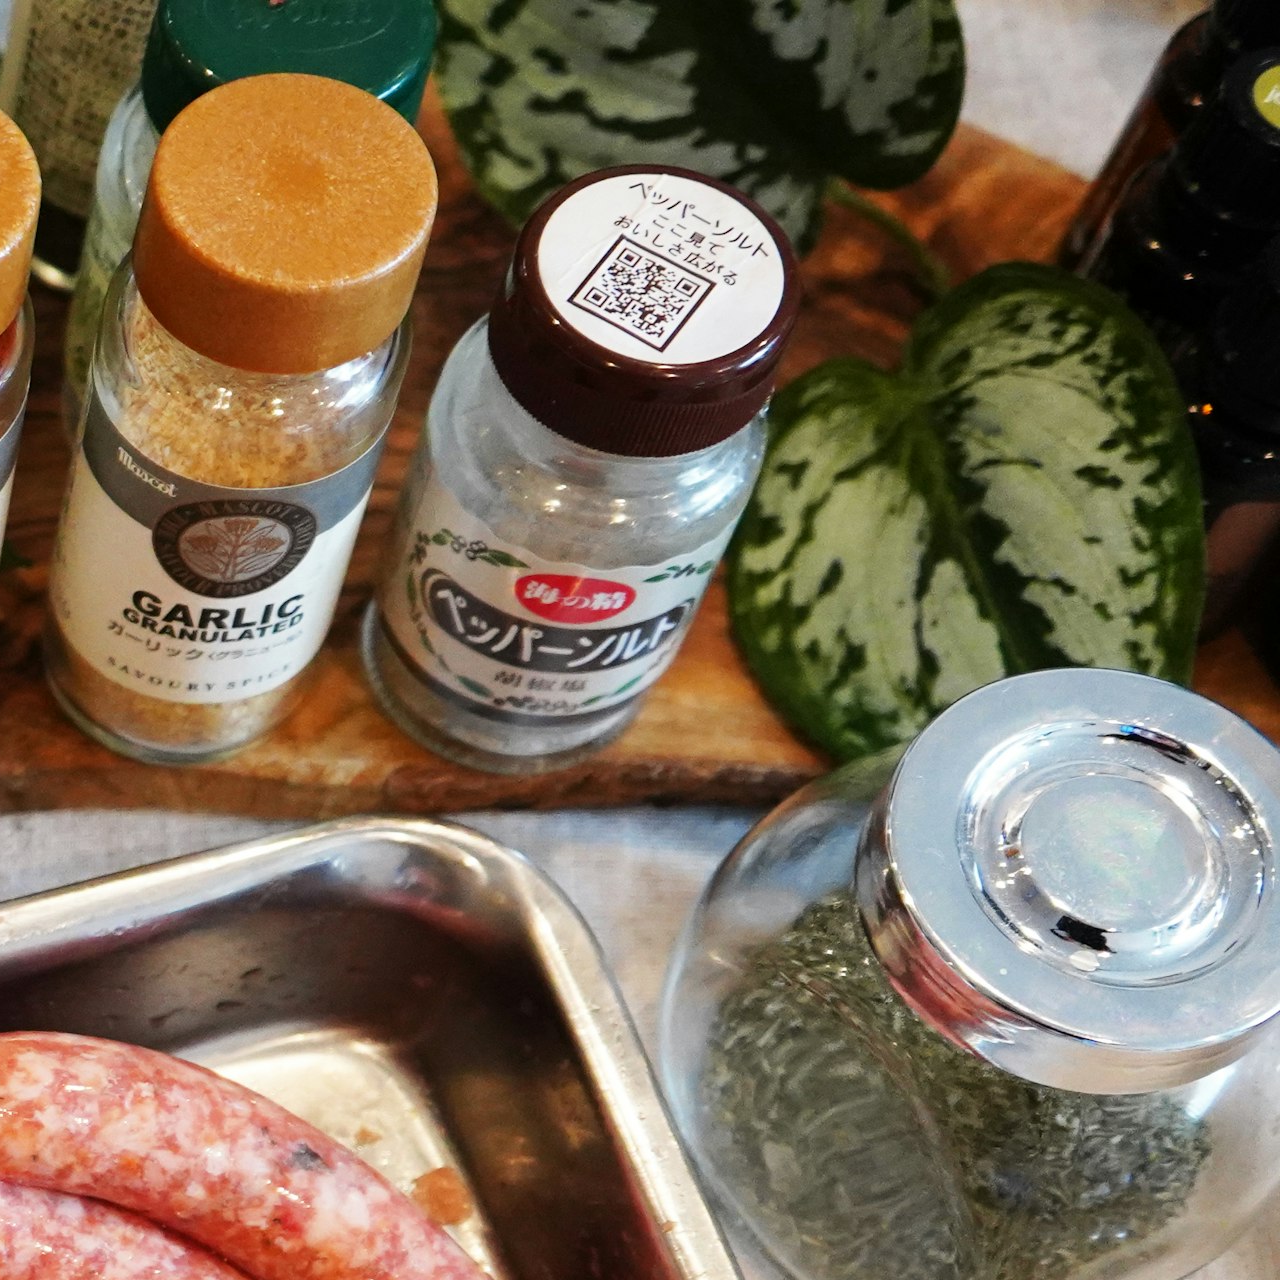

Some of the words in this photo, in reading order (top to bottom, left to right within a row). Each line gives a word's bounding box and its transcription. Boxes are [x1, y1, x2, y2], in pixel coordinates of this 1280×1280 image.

[628, 181, 768, 260] ペッパーソルト
[652, 214, 725, 255] ここ見て
[613, 214, 738, 287] おいしさ広がる
[118, 446, 177, 498] Mascot
[122, 607, 304, 643] GRANULATED
[131, 590, 305, 630] GARLIC
[437, 586, 678, 668] ペッパーソルト
[106, 656, 215, 691] SAVOURY
